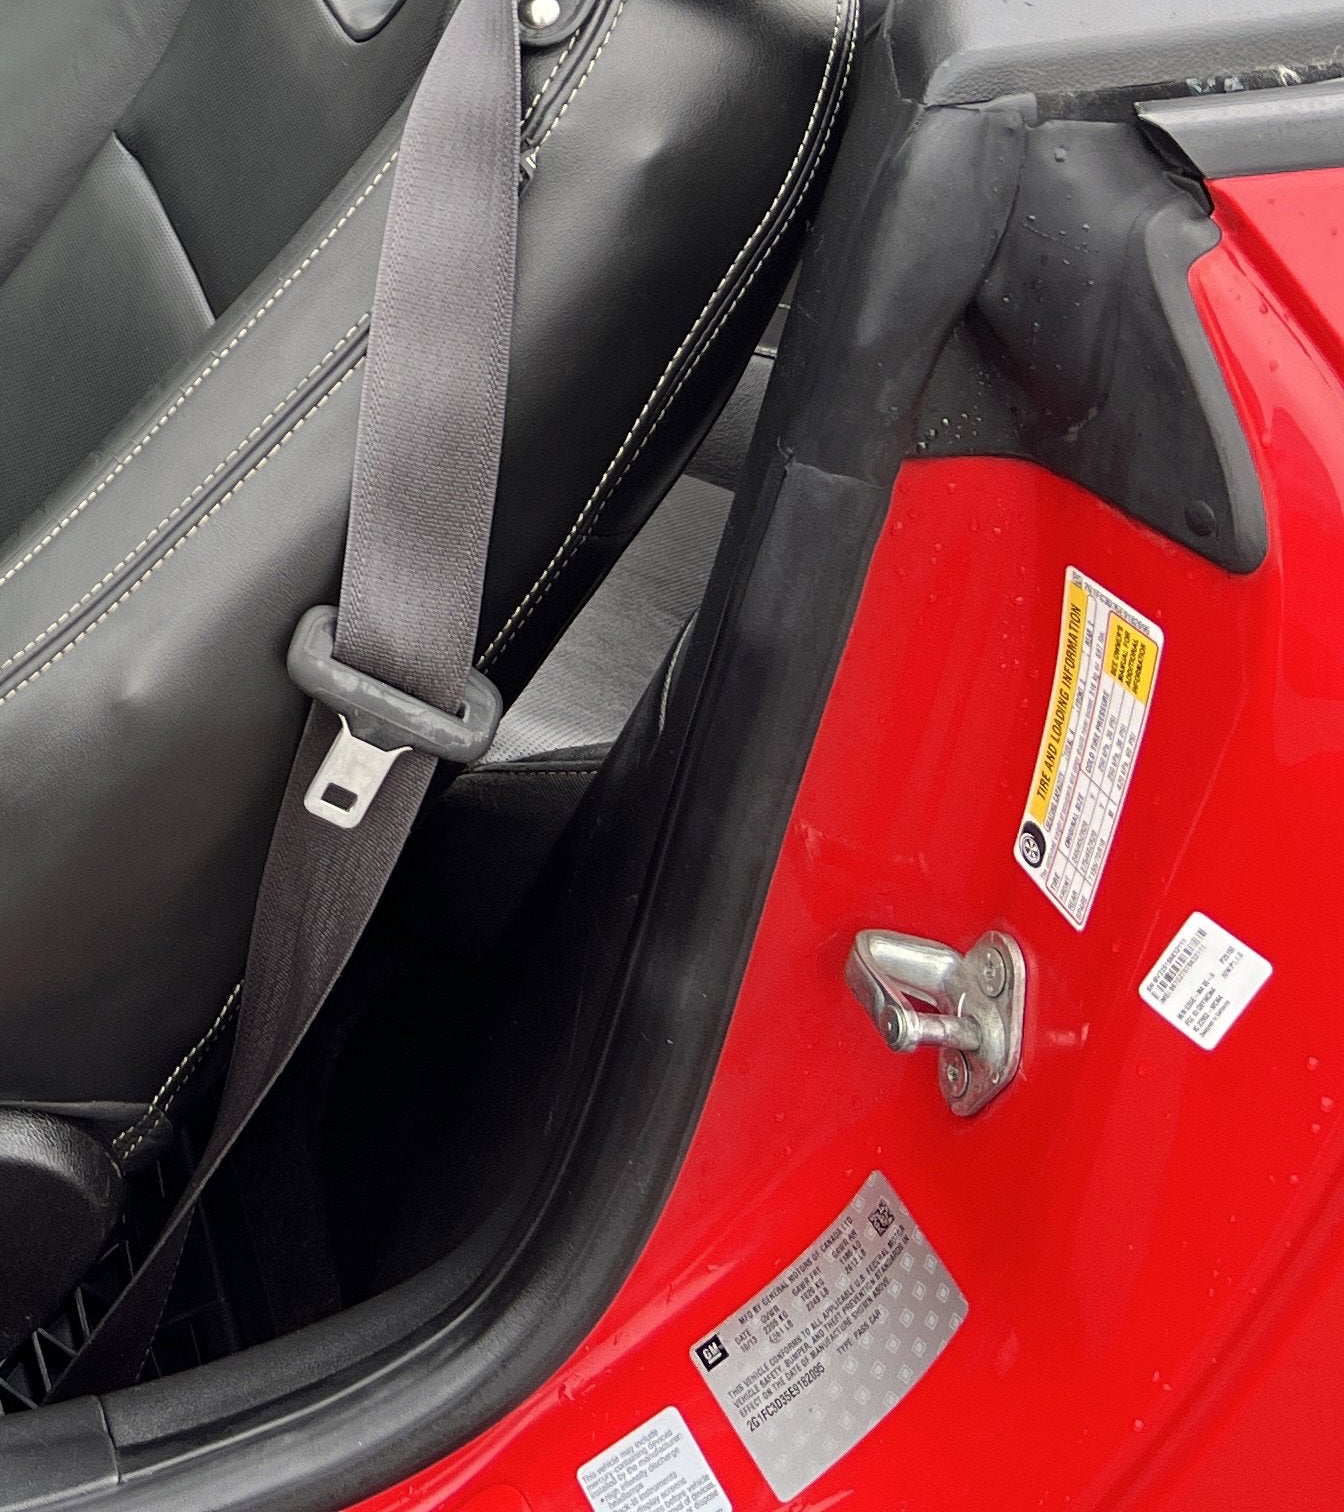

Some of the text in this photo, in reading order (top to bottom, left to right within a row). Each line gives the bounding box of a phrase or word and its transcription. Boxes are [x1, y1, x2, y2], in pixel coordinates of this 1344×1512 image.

[1037, 602, 1079, 800] TIRE AND LOADING INFORMATION
[762, 1279, 789, 1307] GENERAL
[788, 1258, 813, 1284] MOTORS
[820, 1227, 843, 1254] CANADA
[728, 1383, 745, 1400] THIS
[743, 1363, 770, 1388] VEHICLE
[769, 1335, 803, 1368] CONFORMS
[802, 1327, 812, 1339] TO
[811, 1317, 823, 1331] ALL
[822, 1284, 856, 1321] APPLICABLE
[866, 1247, 889, 1275] FEDERAL
[734, 1384, 761, 1409] VEHICLE
[811, 1329, 826, 1345] AND
[825, 1312, 844, 1333] THEFT
[842, 1279, 876, 1316] PREVENTION
[875, 1243, 905, 1281] STANDARDS
[903, 1235, 910, 1247] IN
[735, 1328, 752, 1346] DATE
[854, 1308, 882, 1340] PASS CAR
[703, 1342, 721, 1361] GM
[739, 1395, 764, 1418] EFFECT
[762, 1387, 774, 1401] ON
[772, 1377, 786, 1393] THE
[785, 1364, 802, 1382] DATE
[801, 1356, 812, 1369] OF
[810, 1317, 853, 1360] MANUFACTURE
[852, 1297, 874, 1321] SHOWN
[582, 1428, 658, 1484] This vehicle may include
[647, 1428, 673, 1449] devices
[616, 1470, 627, 1482] by
[626, 1462, 638, 1474] the
